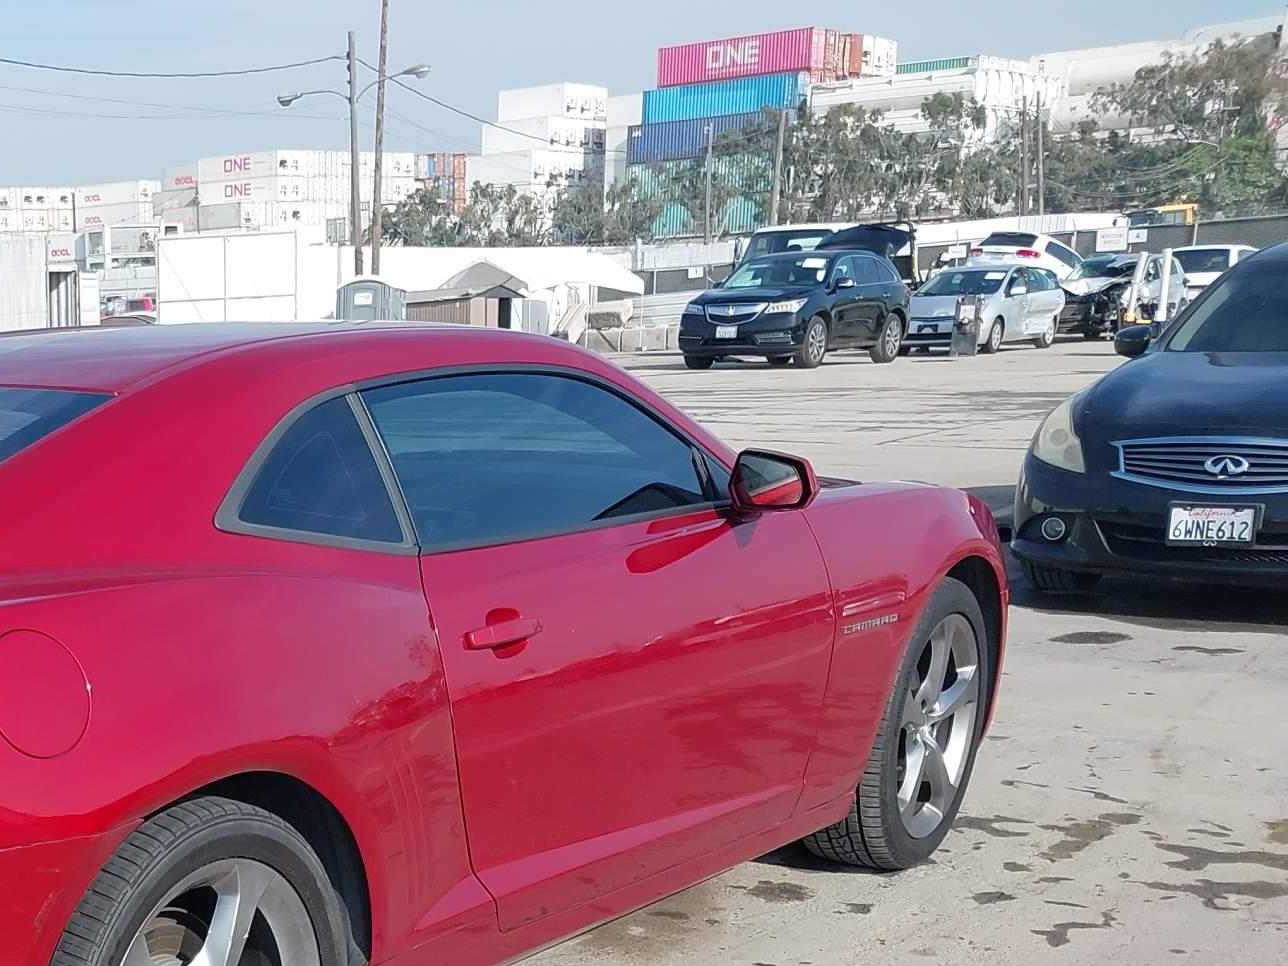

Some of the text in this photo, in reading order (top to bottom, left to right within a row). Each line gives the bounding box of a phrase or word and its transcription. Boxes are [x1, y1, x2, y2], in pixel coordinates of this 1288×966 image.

[706, 40, 760, 68] ONE
[223, 157, 251, 173] ONE
[224, 183, 252, 198] ONE
[51, 249, 71, 258] OOCL
[1187, 508, 1241, 520] California
[1172, 520, 1250, 540] 6WNE612
[842, 613, 899, 634] CAMARO
